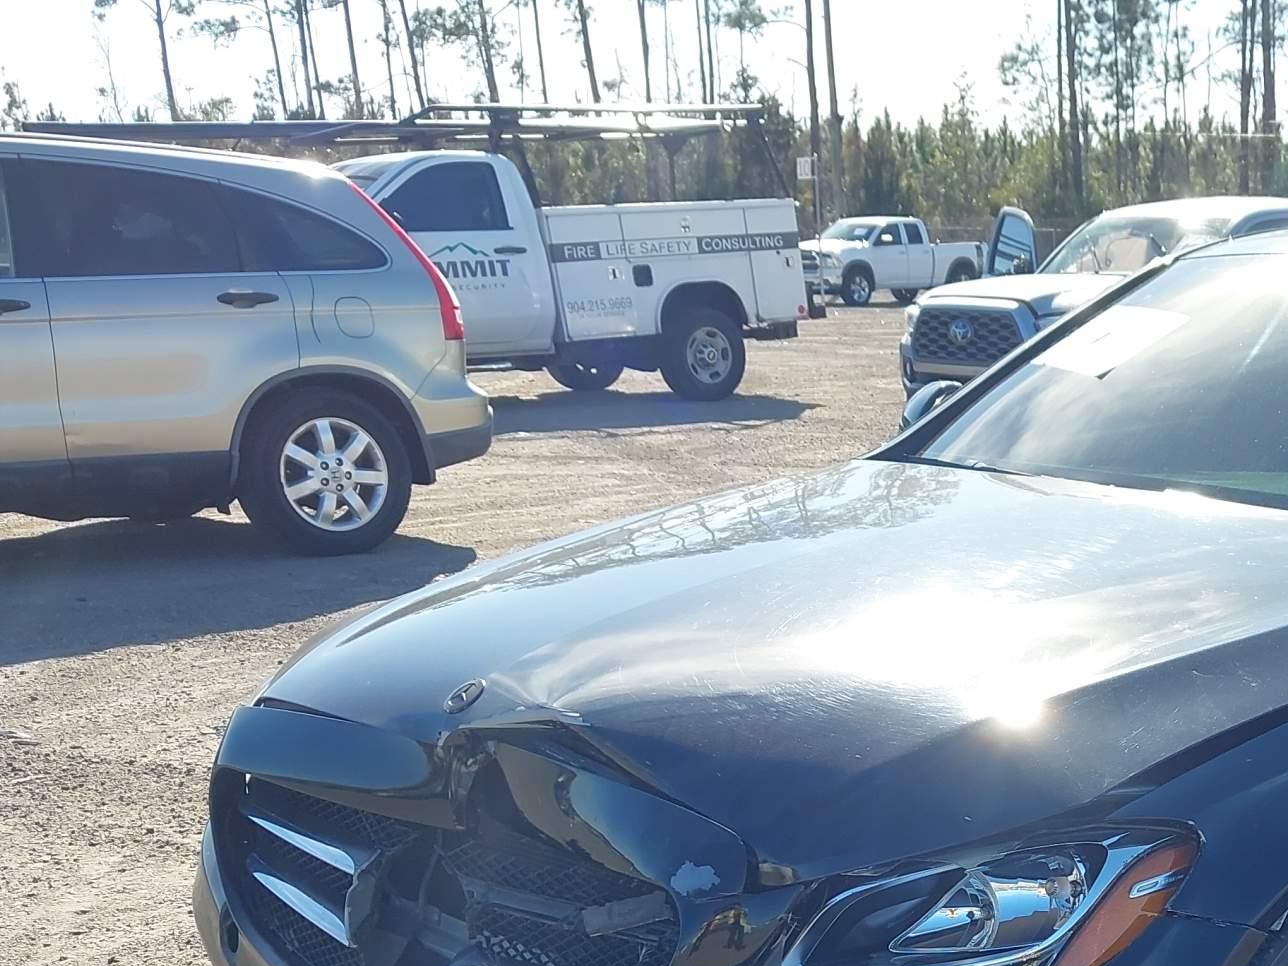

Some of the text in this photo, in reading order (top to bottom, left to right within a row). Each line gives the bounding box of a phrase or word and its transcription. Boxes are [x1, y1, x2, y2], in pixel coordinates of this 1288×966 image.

[564, 235, 784, 260] FIRE LIFE SAFETY CONSULTING
